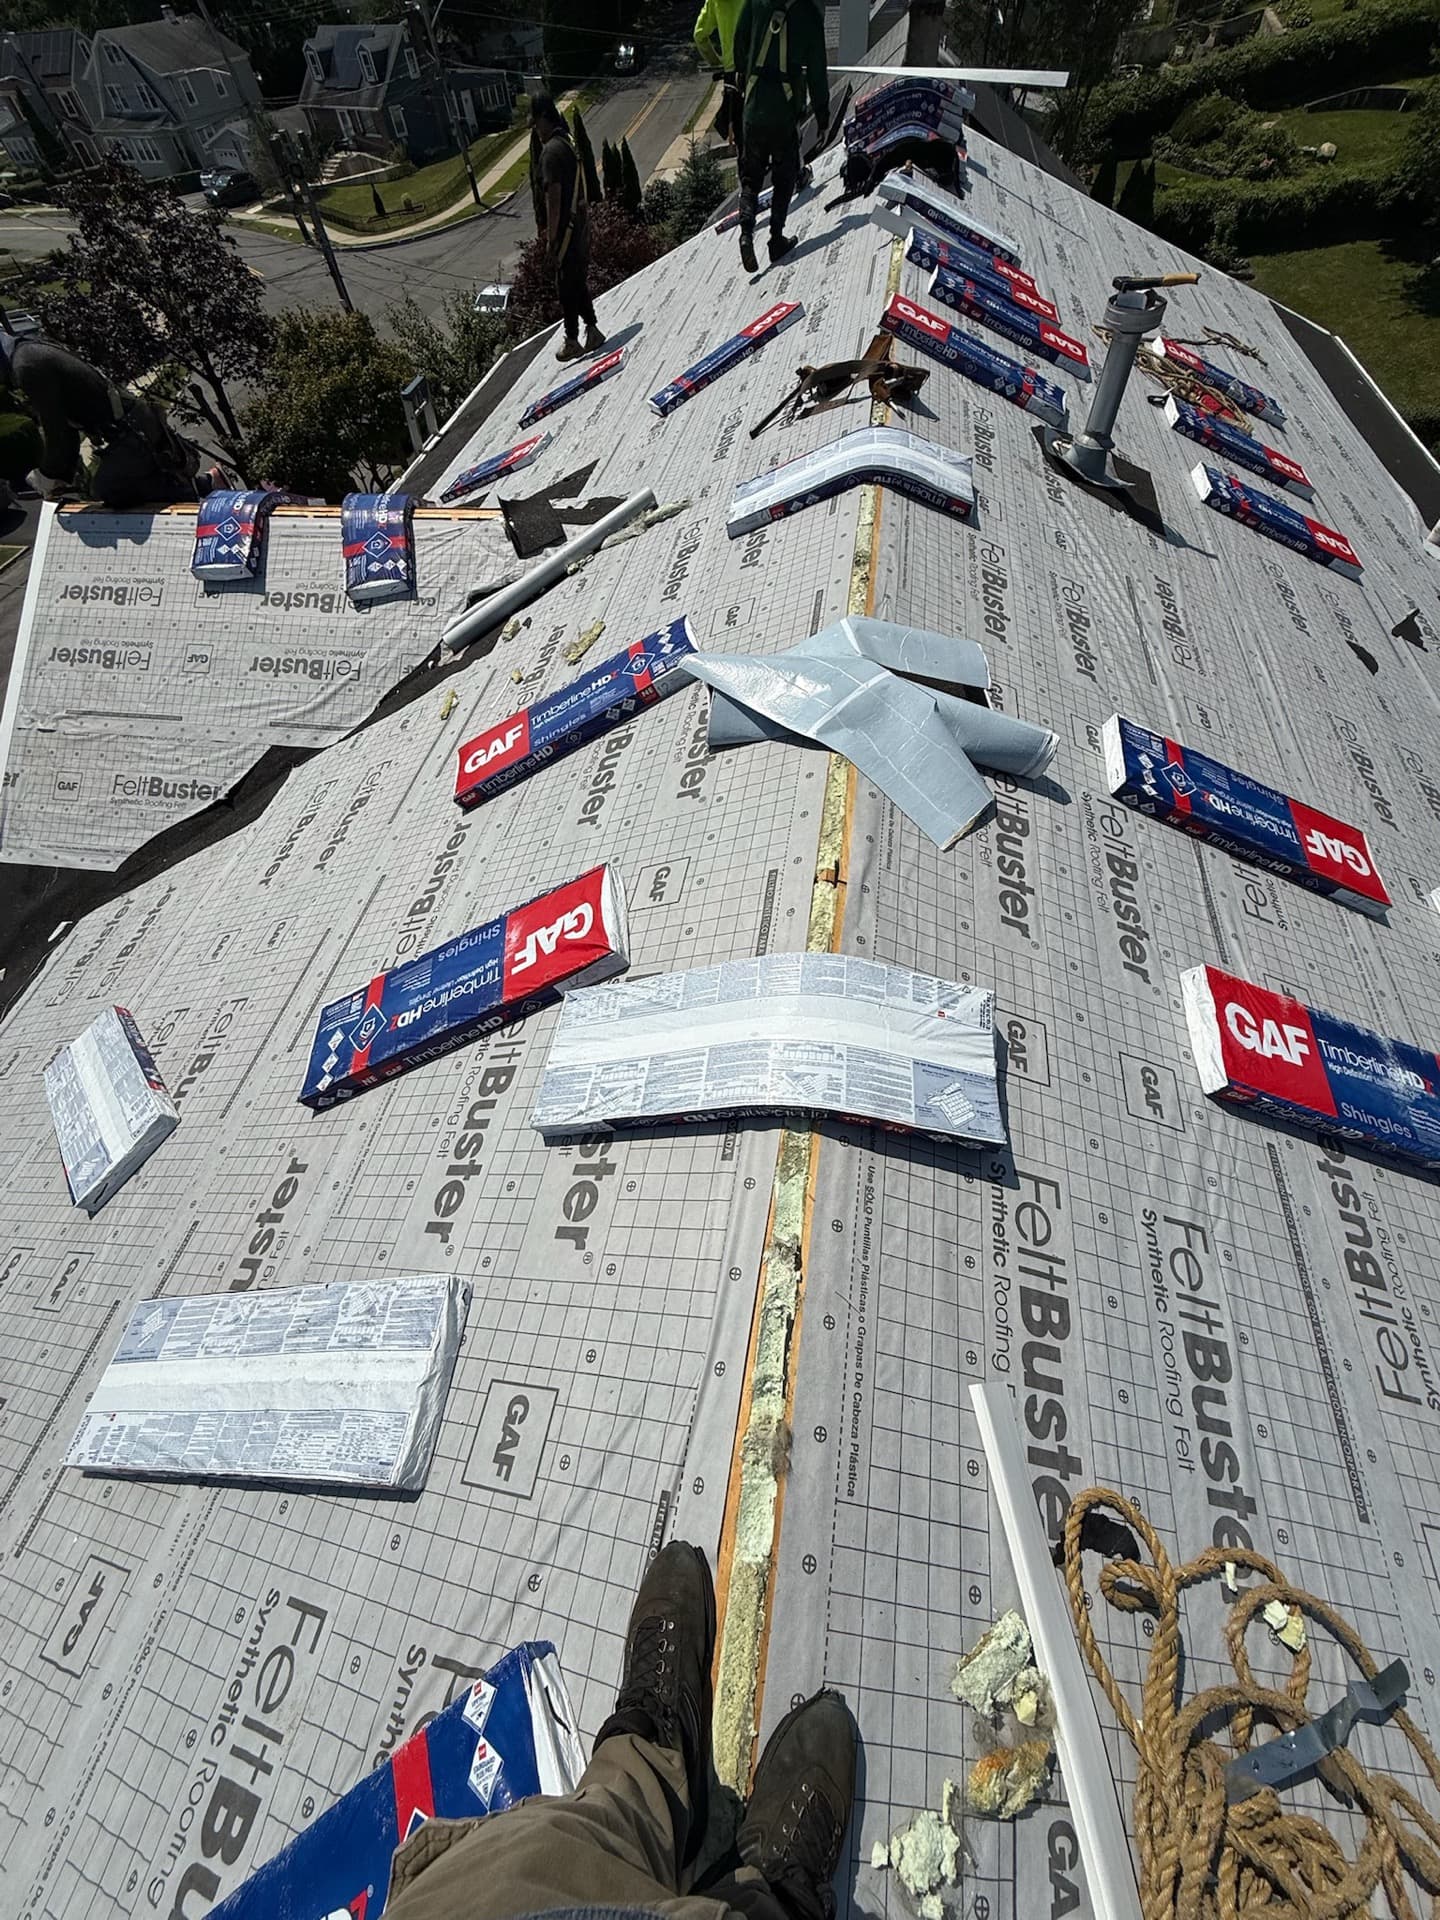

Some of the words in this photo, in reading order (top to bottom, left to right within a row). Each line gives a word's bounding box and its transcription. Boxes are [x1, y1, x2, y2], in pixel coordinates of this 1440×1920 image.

[897, 302, 946, 333] GAF
[1043, 332, 1084, 357] GAF
[972, 403, 997, 473] FeltBuster
[60, 584, 164, 607] FeltBuster
[728, 605, 739, 628] GAF
[980, 538, 1011, 646] FeltBuster
[1263, 557, 1312, 637] FeltBuster
[1061, 575, 1097, 684] FeltBuster
[48, 646, 152, 671] FeltBuster
[187, 653, 208, 665] GAF
[249, 656, 362, 682] FeltBuster
[464, 724, 524, 773] GAF
[1334, 715, 1399, 831] FeltBuster
[57, 780, 78, 792] GAF
[113, 774, 223, 801] FeltBuster
[1079, 791, 1097, 843] Synthetic
[994, 773, 1035, 941] eltBuster
[1306, 829, 1372, 876] GAF
[649, 866, 671, 903] GAF
[1097, 798, 1151, 985] FeltBuster
[87, 886, 177, 1000] FeltBuster
[437, 923, 501, 963] Shingles
[511, 902, 594, 975] GAF
[1007, 1019, 1028, 1074] GAF
[1224, 1002, 1311, 1067] GAF
[447, 1066, 482, 1127] Roofing
[1139, 1066, 1165, 1120] GAF
[436, 1130, 457, 1160] Felt
[1341, 1102, 1412, 1140] Shingles
[866, 1165, 875, 1183] Use
[864, 1185, 875, 1215] SÓLO
[989, 1161, 1008, 1268] Synthetic
[1361, 1191, 1381, 1222] Felt
[269, 1230, 290, 1260] Felt
[861, 1216, 872, 1261] Puntillas
[50, 1257, 80, 1305] GAF
[856, 1263, 871, 1313] Plásticas
[1379, 1229, 1407, 1300] Roofing
[857, 1315, 864, 1323] o
[993, 1274, 1013, 1373] Roofing
[1141, 1208, 1168, 1313] Synthetic
[1158, 1320, 1185, 1417] Roofing
[1173, 1425, 1196, 1475] Felt
[854, 1325, 867, 1370] Grapas
[1014, 1170, 1083, 1548] FeltBuste
[1403, 1306, 1440, 1411] Synthetic
[854, 1371, 863, 1389] De
[1294, 1255, 1311, 1292] TECHOS
[1305, 1298, 1318, 1321] CON
[1313, 1324, 1328, 1357] EXTRA
[1336, 1422, 1366, 1516] INCORPORADA
[493, 1394, 530, 1482] GAF
[850, 1393, 864, 1438] Cabeza
[846, 1442, 862, 1499] Plástica
[63, 1570, 107, 1657] GAF
[152, 1609, 167, 1634] Use
[209, 1587, 281, 1749] Synthetic
[40, 1823, 71, 1882] Grapas
[147, 1757, 218, 1911] Roofing
[1047, 1819, 1081, 1920] GA
[29, 1884, 45, 1909] De
